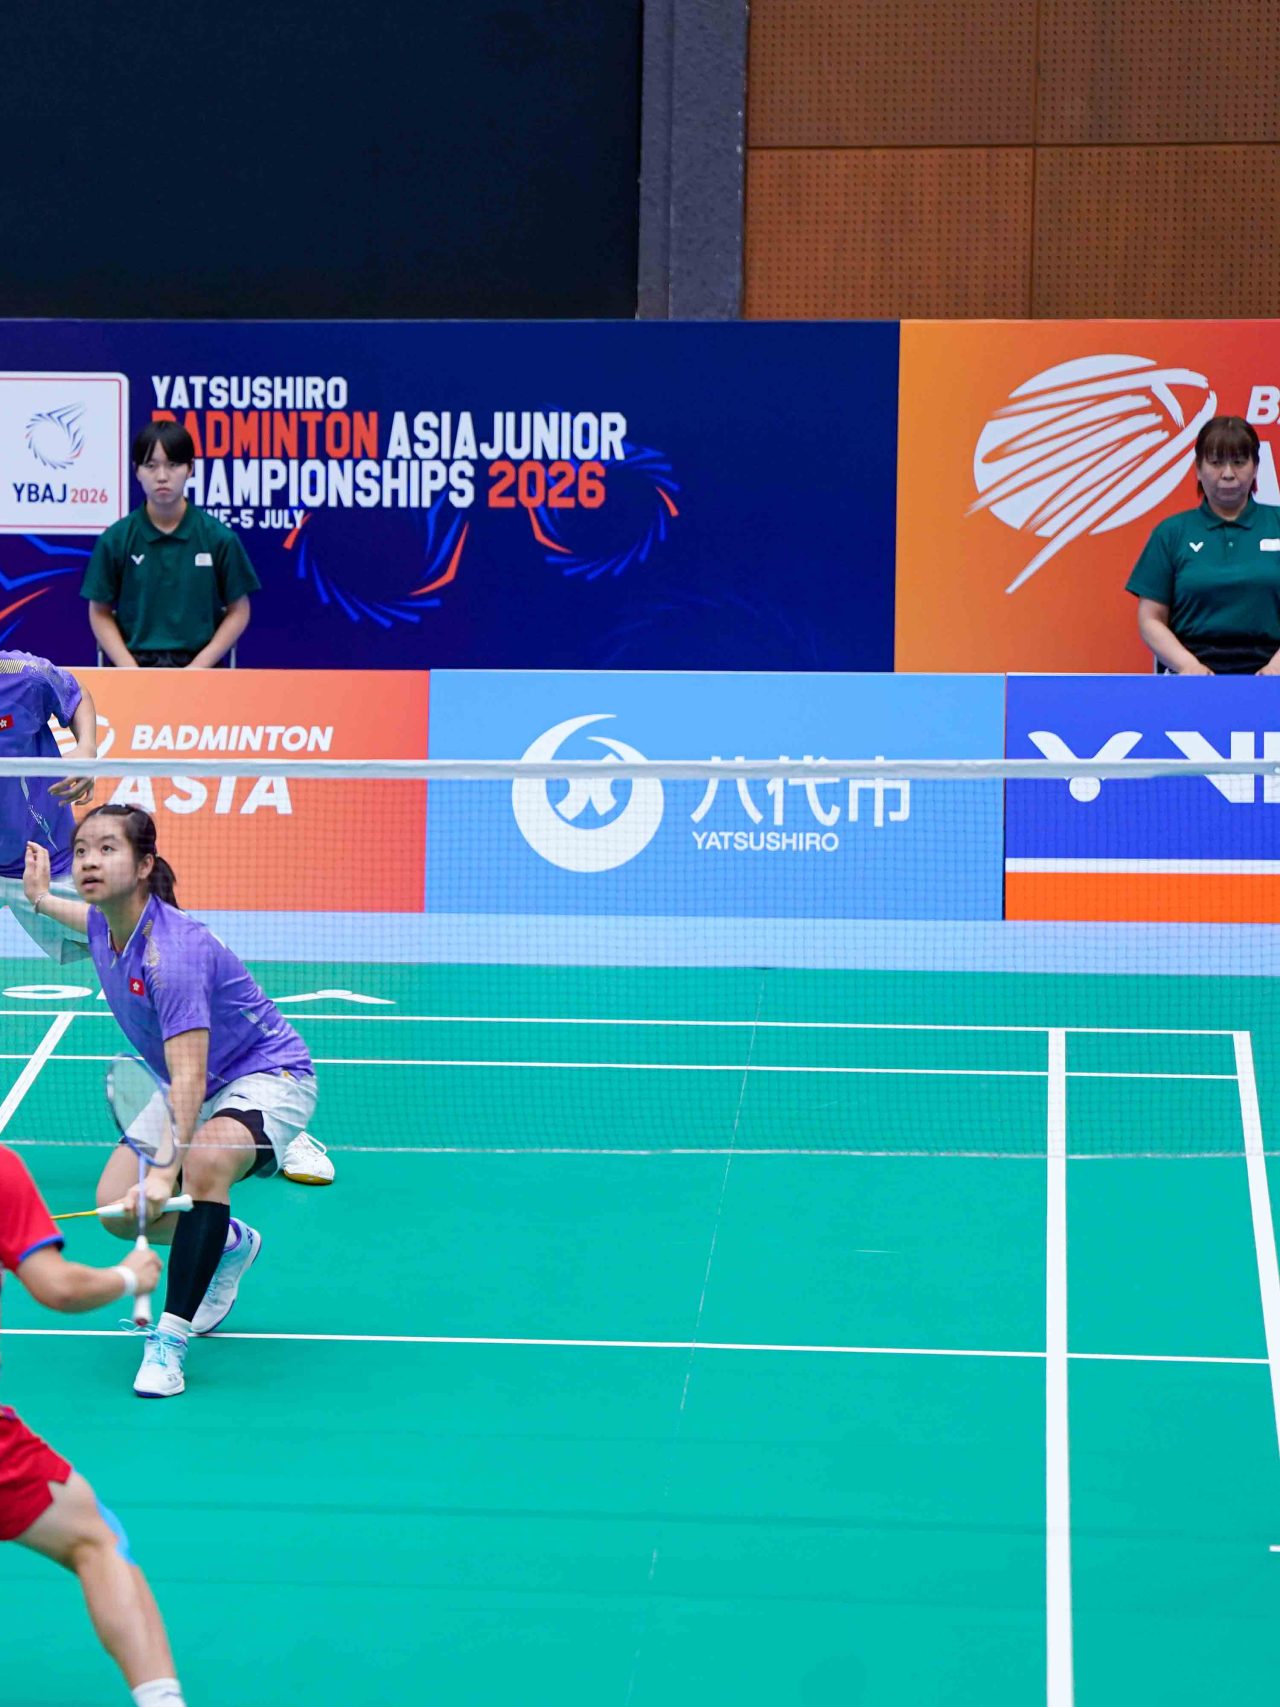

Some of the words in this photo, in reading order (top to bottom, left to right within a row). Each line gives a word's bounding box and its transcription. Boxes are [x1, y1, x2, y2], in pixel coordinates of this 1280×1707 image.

[151, 375, 348, 410] YATSUSHIRO
[151, 410, 378, 459] ADMINTON
[387, 411, 478, 460] ASIA
[479, 411, 627, 460] JUNIOR
[12, 482, 67, 503] YBAJ
[70, 487, 109, 503] 2026
[183, 458, 475, 508] HAMPIONSHIPS
[487, 460, 606, 509] 2026
[259, 508, 304, 529] JULY
[131, 725, 334, 752] BADMINTON
[690, 755, 911, 827] 八代市
[692, 831, 840, 852] YATSUSHIRO
